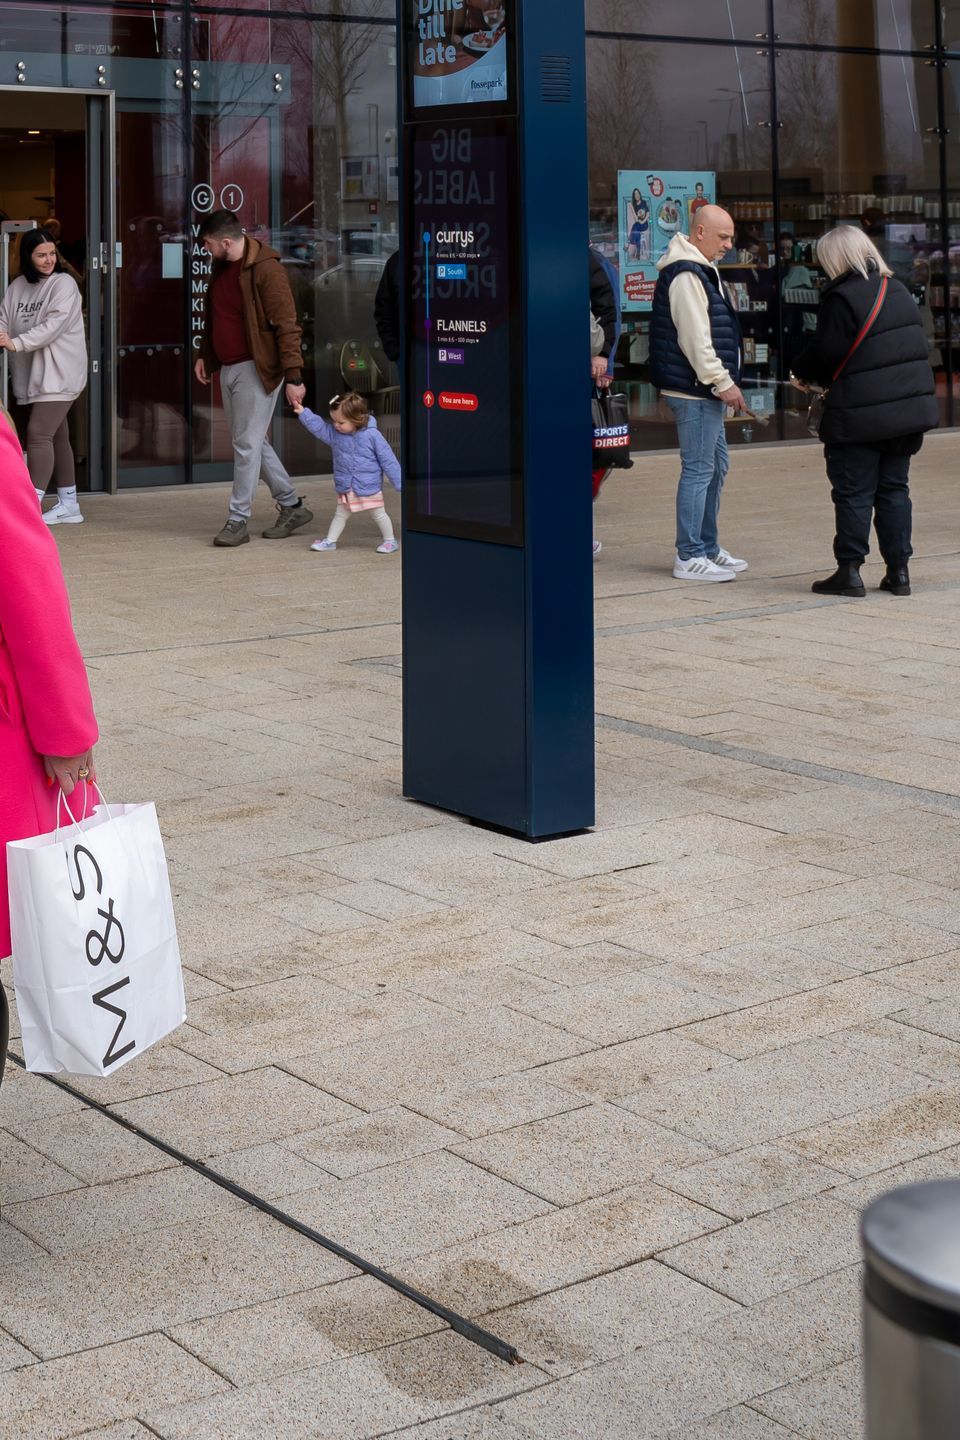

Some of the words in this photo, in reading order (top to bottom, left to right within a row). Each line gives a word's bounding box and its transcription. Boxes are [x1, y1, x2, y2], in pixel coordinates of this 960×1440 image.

[418, 14, 446, 39] till
[418, 42, 456, 66] late
[197, 191, 209, 205] G
[436, 230, 474, 248] currys
[447, 267, 463, 275] South
[437, 319, 487, 333] FLANNELS
[448, 352, 462, 361] West
[461, 397, 474, 405] here
[594, 425, 628, 437] SPORTS
[595, 436, 628, 448] DIRECT
[65, 843, 136, 1069] M&S
